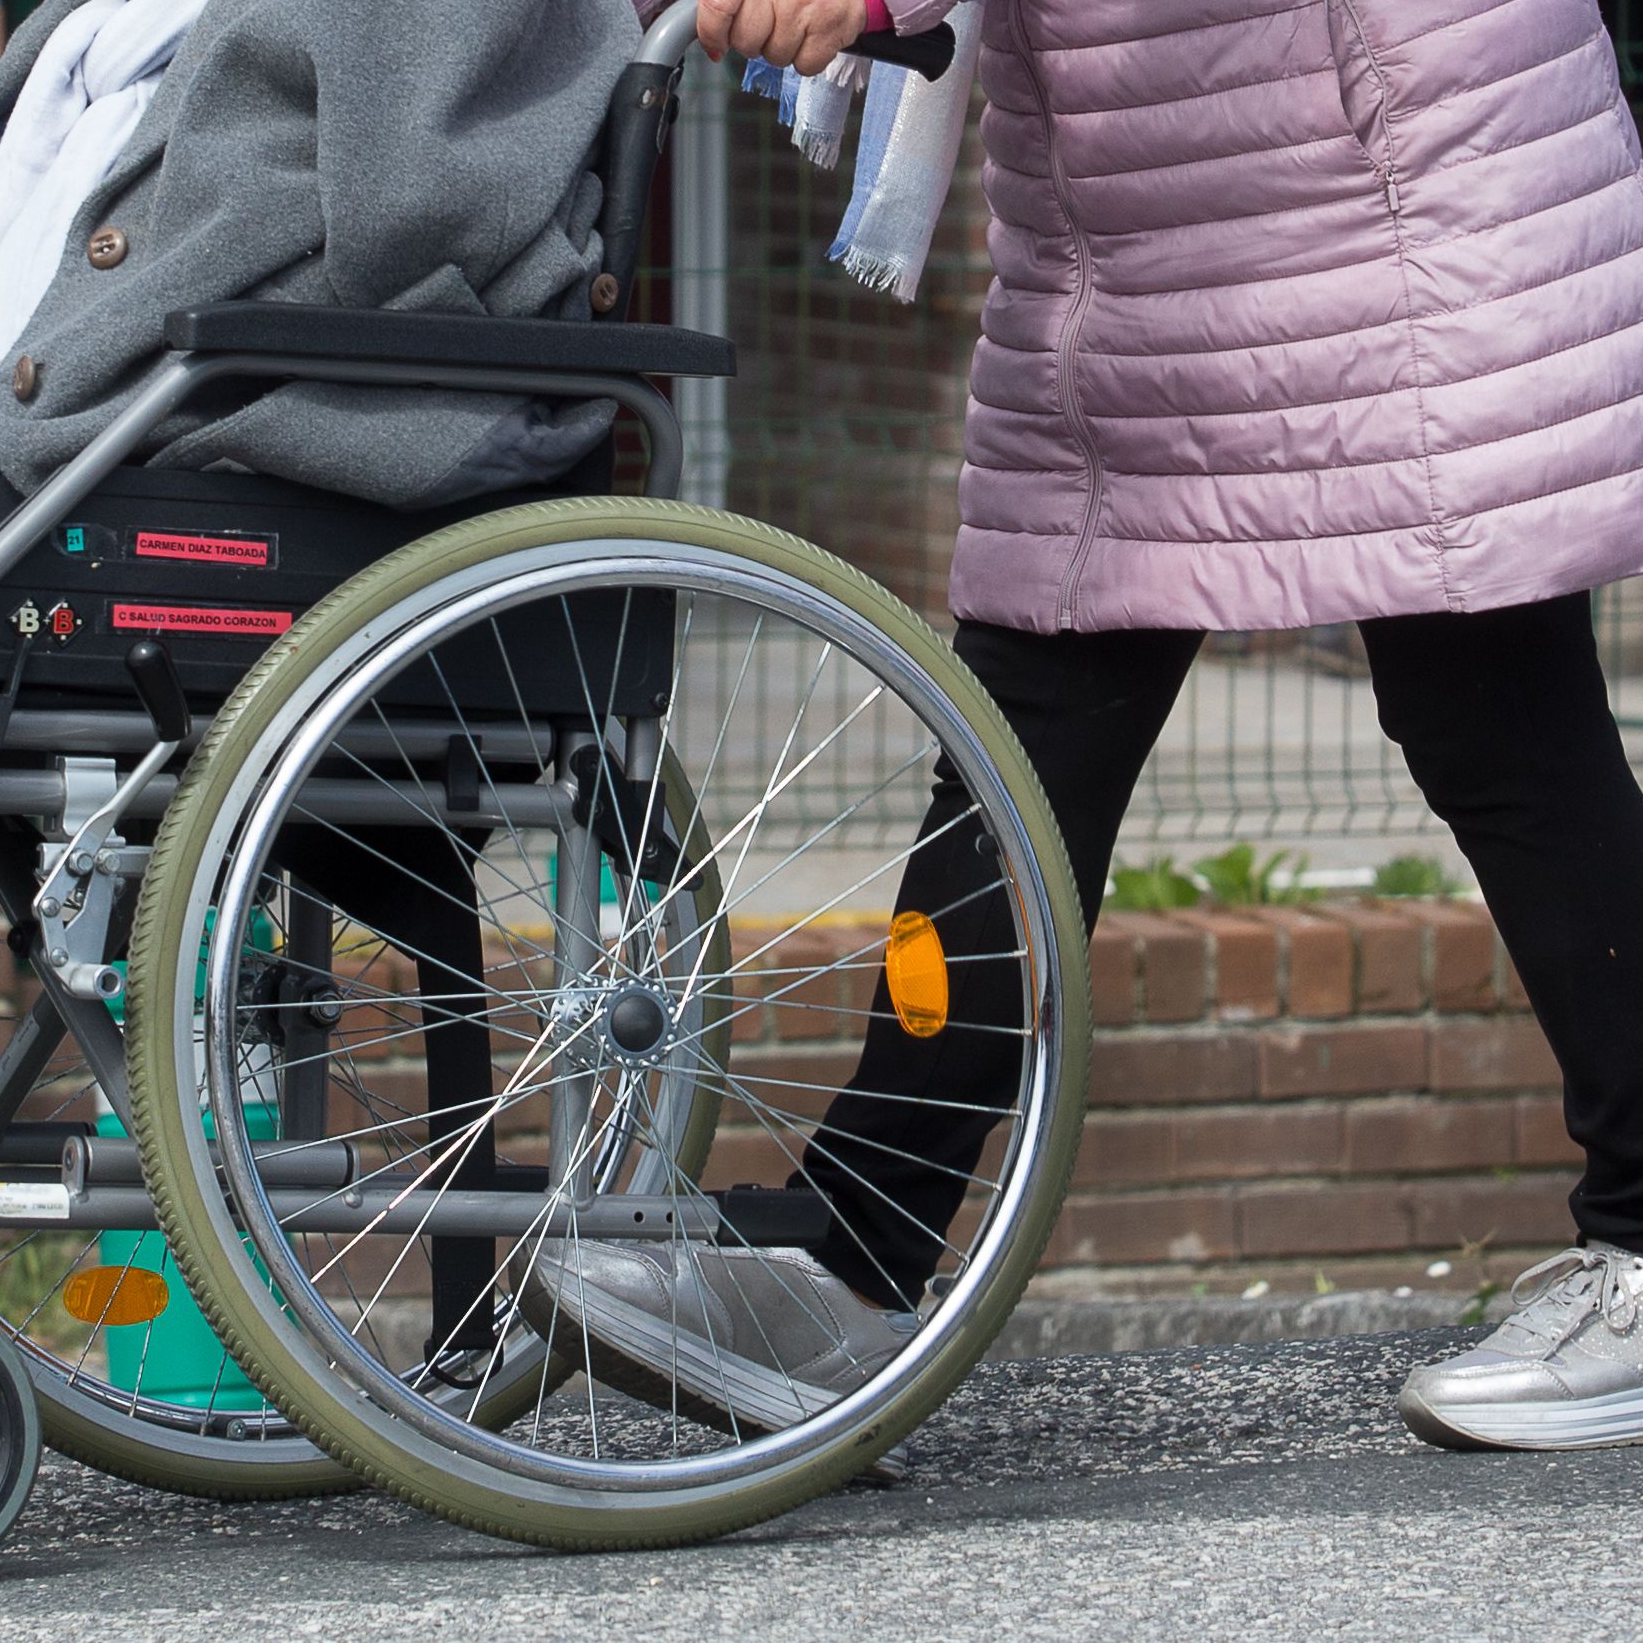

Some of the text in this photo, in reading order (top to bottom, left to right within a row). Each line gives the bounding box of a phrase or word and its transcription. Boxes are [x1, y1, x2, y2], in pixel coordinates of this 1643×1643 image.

[68, 535, 80, 545] 21
[140, 539, 266, 559] CARMEN DIAZ TABOADA
[118, 612, 277, 628] C SALUD SAGRADO CORAZON
